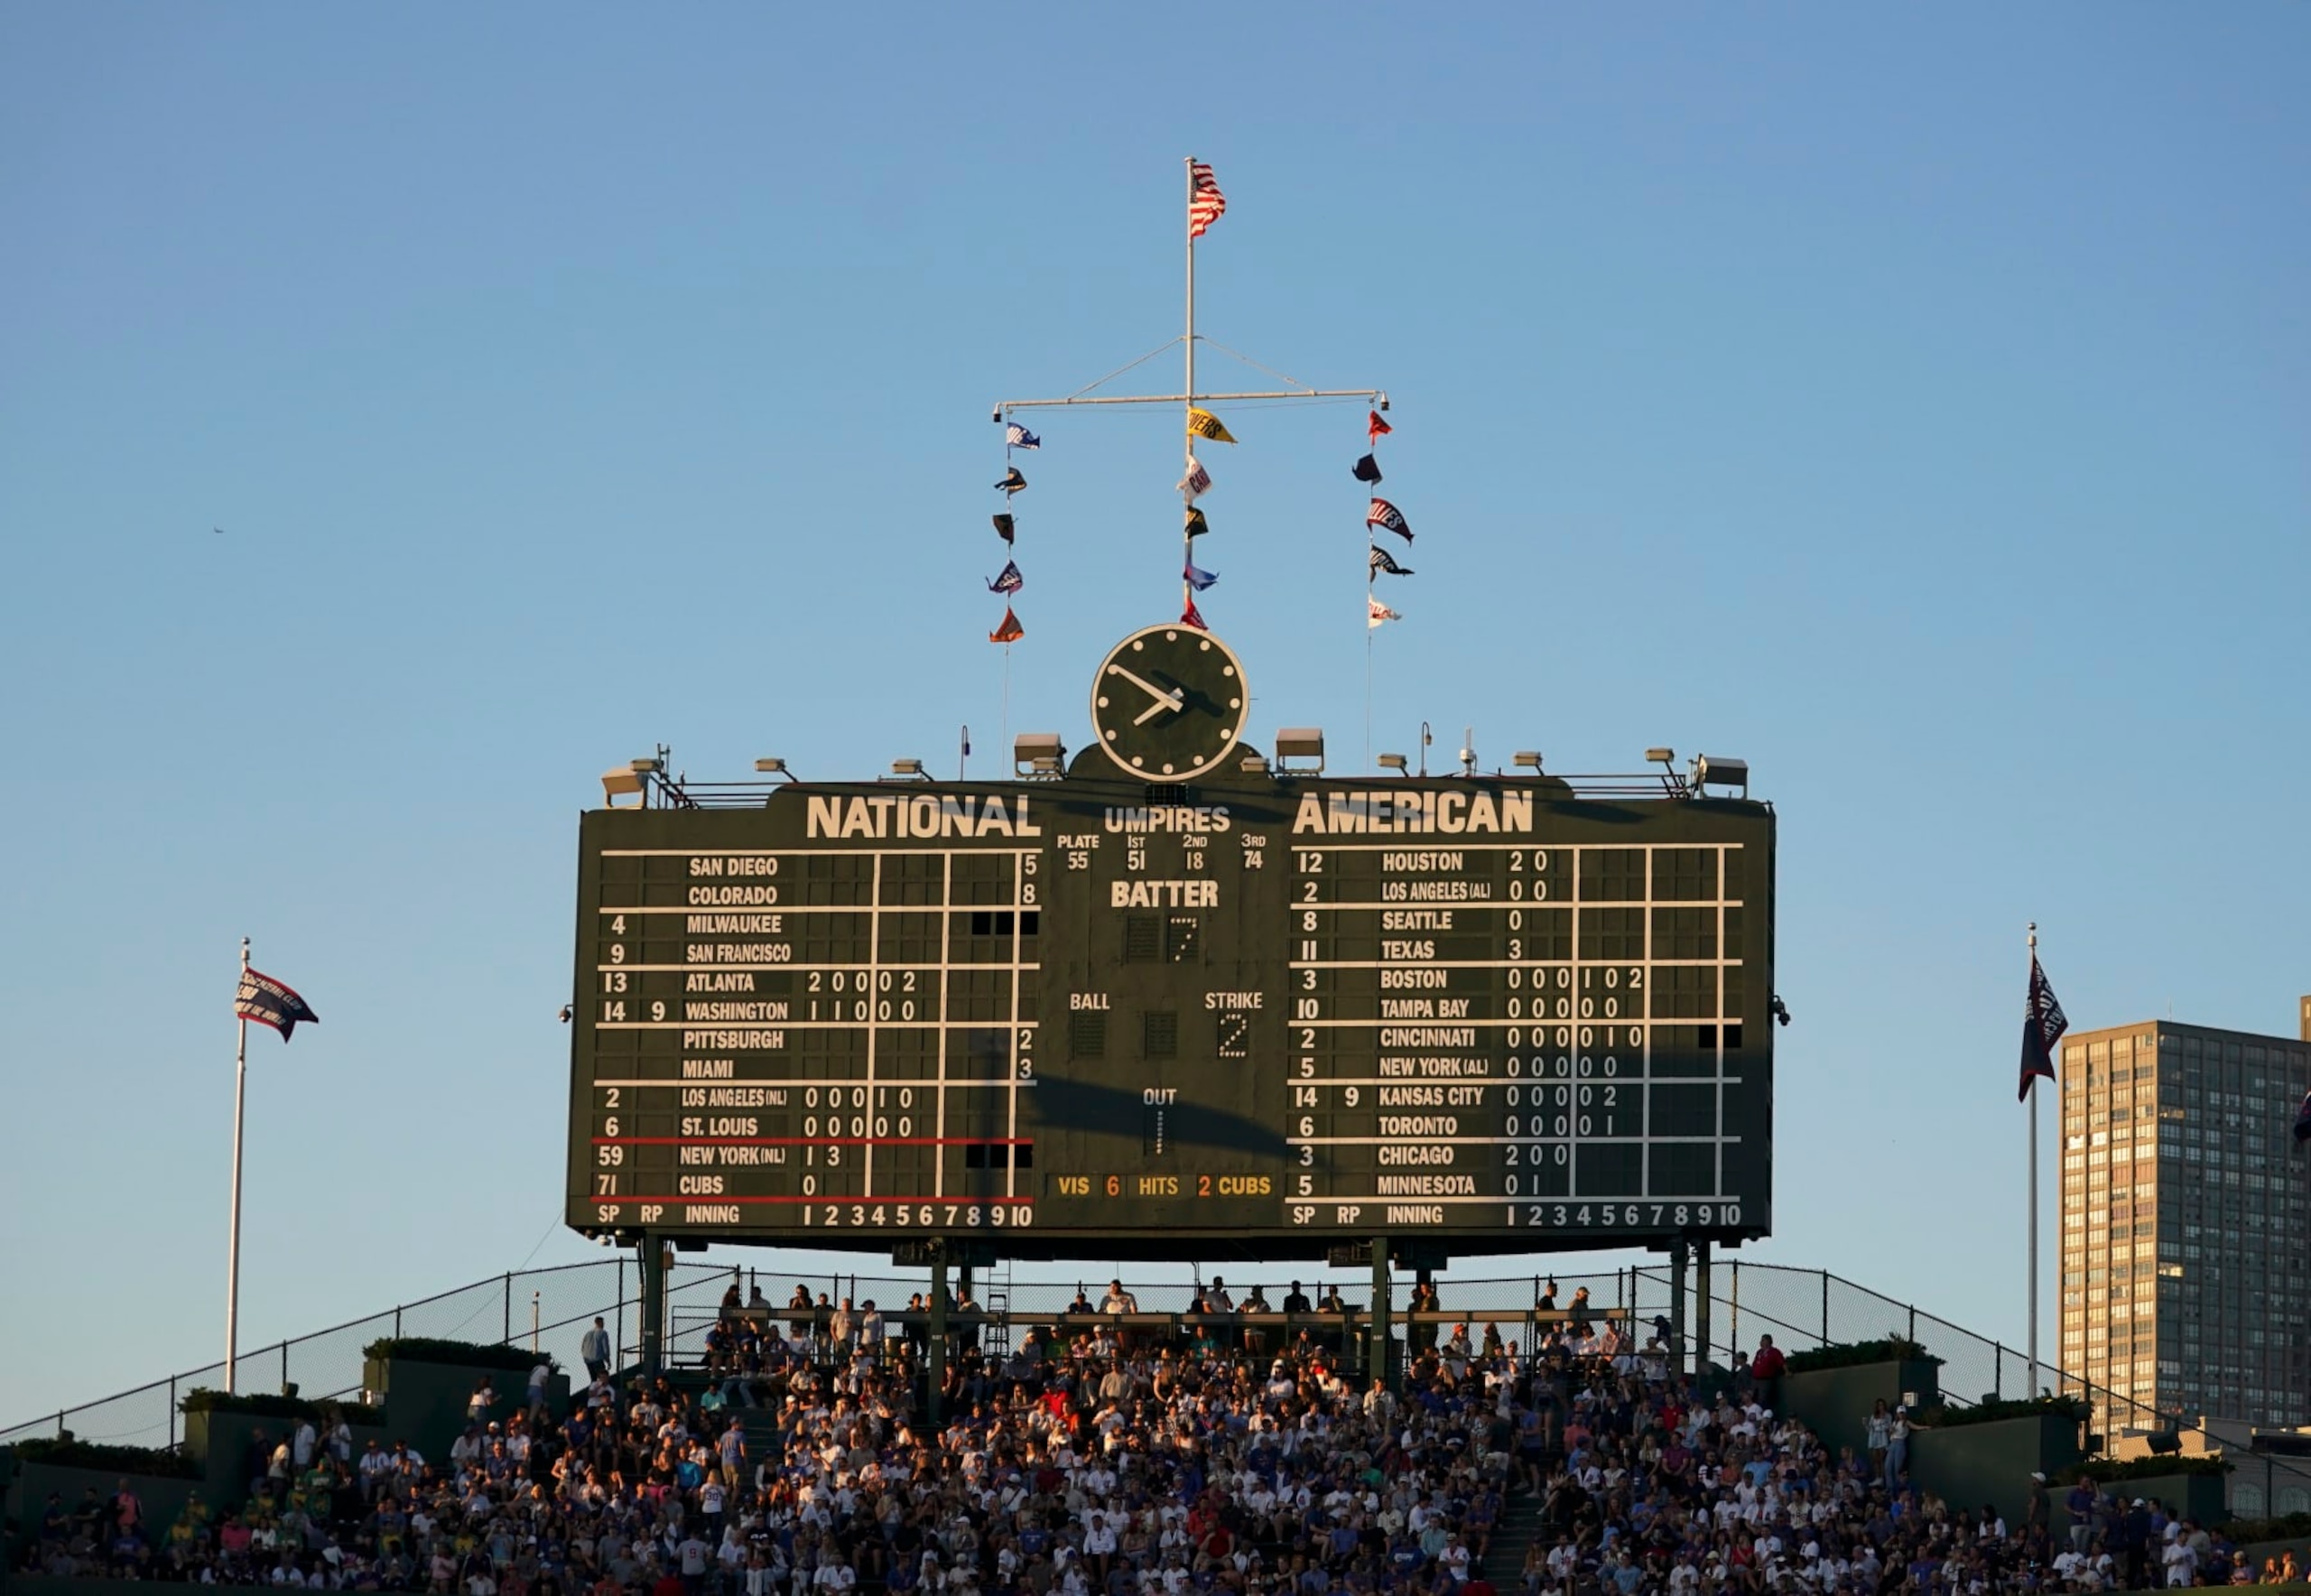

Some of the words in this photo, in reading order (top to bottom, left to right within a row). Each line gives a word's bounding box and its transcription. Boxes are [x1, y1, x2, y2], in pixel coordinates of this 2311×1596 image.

[807, 795, 1041, 838] NATIONAL
[1105, 808, 1230, 832] UMPIRES
[1293, 791, 1532, 833] AMERICAN
[1058, 835, 1099, 848] PLATE
[1128, 835, 1145, 848] 1ST
[1183, 834, 1207, 847] 2ND
[1241, 834, 1266, 847] 3RD
[691, 858, 722, 876] SAN
[729, 858, 777, 875] DIEGO
[1026, 855, 1036, 875] 5
[1069, 851, 1088, 868] 55
[1128, 850, 1145, 869] 51
[1187, 852, 1203, 869] 18
[1245, 850, 1263, 868] 74
[1300, 853, 1322, 872] 12
[1384, 853, 1462, 870] HOUSTON
[1511, 851, 1522, 871] 2
[1536, 851, 1546, 870] 0
[690, 886, 777, 905] COLORADO
[1024, 884, 1035, 904] 8
[1111, 880, 1218, 907] BATTER
[1304, 882, 1317, 902] 2
[1383, 883, 1406, 900] LOS
[1510, 881, 1522, 900] 0
[1535, 880, 1546, 900] 0
[612, 915, 626, 934] 4
[688, 915, 781, 933] MILWAUKEE
[1304, 912, 1316, 931] 8
[1383, 912, 1452, 929] SEATTLE
[1509, 910, 1521, 930] 0
[1171, 918, 1197, 960] 7
[611, 944, 624, 963] 9
[688, 945, 713, 961] SAN
[718, 944, 790, 961] FRANCISCO
[1303, 941, 1316, 960] 11
[1382, 941, 1434, 959] TEXAS
[1509, 940, 1521, 960] 3
[606, 973, 626, 992] 13
[686, 974, 754, 991] ATLANTA
[809, 972, 821, 991] 2
[832, 971, 844, 991] 0
[856, 972, 868, 991] 0
[879, 971, 891, 991] 0
[904, 971, 914, 991] 2
[1303, 970, 1316, 989] 3
[1381, 970, 1446, 988] BOSTON
[1508, 969, 1520, 988] 0
[1533, 969, 1545, 988] 0
[1557, 968, 1569, 988] 0
[1606, 968, 1617, 988] 0
[1630, 968, 1641, 988] 2
[1071, 994, 1109, 1009] BALL
[1206, 992, 1262, 1008] STRIKE
[1299, 999, 1318, 1018] 10
[1381, 1000, 1433, 1017] TAMPA
[1439, 1000, 1469, 1017] BAY
[605, 1002, 626, 1021] 14
[652, 1002, 664, 1021] 9
[686, 1003, 787, 1019] WASHINGTON
[684, 1031, 783, 1048] PITTSBURGH
[1020, 1029, 1031, 1049] 2
[1220, 1014, 1247, 1057] 2
[1302, 1028, 1314, 1048] 2
[1381, 1029, 1474, 1046] CINCINNATI
[683, 1061, 732, 1077] MIAMI
[1020, 1059, 1031, 1078] 3
[1302, 1058, 1313, 1077] 5
[1380, 1058, 1415, 1075] NEW
[606, 1089, 619, 1107] 2
[682, 1089, 705, 1106] LOS
[806, 1088, 817, 1108] 0
[830, 1088, 841, 1108] 0
[853, 1088, 864, 1107] 0
[900, 1089, 912, 1108] 0
[1144, 1089, 1177, 1104] OUT
[1296, 1087, 1317, 1107] 14
[1345, 1087, 1359, 1107] 9
[1380, 1088, 1443, 1105] KANSAS
[1448, 1087, 1483, 1105] CITY
[606, 1117, 618, 1137] 6
[682, 1118, 703, 1136] ST.
[710, 1118, 757, 1136] LOUIS
[1300, 1117, 1313, 1137] 6
[1379, 1117, 1456, 1135] TORONTO
[599, 1146, 623, 1165] 59
[682, 1147, 714, 1164] NEW
[828, 1146, 839, 1165] 3
[1300, 1146, 1313, 1165] 3
[1379, 1146, 1453, 1165] CHICAGO
[1507, 1146, 1517, 1165] 2
[1530, 1145, 1542, 1165] 0
[1555, 1145, 1566, 1165] 0
[599, 1174, 616, 1195] 71
[681, 1176, 723, 1193] CUBS
[803, 1175, 815, 1195] 0
[1059, 1177, 1089, 1194] VIS
[1108, 1176, 1118, 1195] 6
[1140, 1177, 1177, 1194] HITS
[1199, 1176, 1210, 1195] 2
[1220, 1177, 1270, 1194] CUBS
[1299, 1176, 1312, 1195] 5
[1378, 1176, 1475, 1193] MINNESOTA
[1506, 1174, 1517, 1194] 0
[599, 1205, 619, 1222] SP
[642, 1205, 663, 1221] RP
[687, 1206, 738, 1222] INNING
[825, 1206, 838, 1225] 2
[851, 1205, 864, 1225] 3
[872, 1206, 886, 1225] 4
[897, 1205, 909, 1225] 5
[920, 1205, 933, 1225] 6
[945, 1206, 957, 1225] 7
[967, 1207, 979, 1225] 8
[992, 1206, 1004, 1225] 9
[1013, 1207, 1031, 1226] 10
[1294, 1207, 1315, 1223] SP
[1338, 1207, 1360, 1223] RP
[1388, 1206, 1442, 1222] INNING
[1529, 1206, 1542, 1225] 2
[1554, 1205, 1566, 1225] 3
[1577, 1206, 1591, 1225] 4
[1602, 1205, 1615, 1225] 5
[1625, 1205, 1638, 1225] 6
[1651, 1205, 1663, 1225] 7
[1675, 1205, 1687, 1225] 8
[1698, 1205, 1712, 1225] 9
[1721, 1205, 1740, 1225] 10
[707, 1491, 719, 1501] 30
